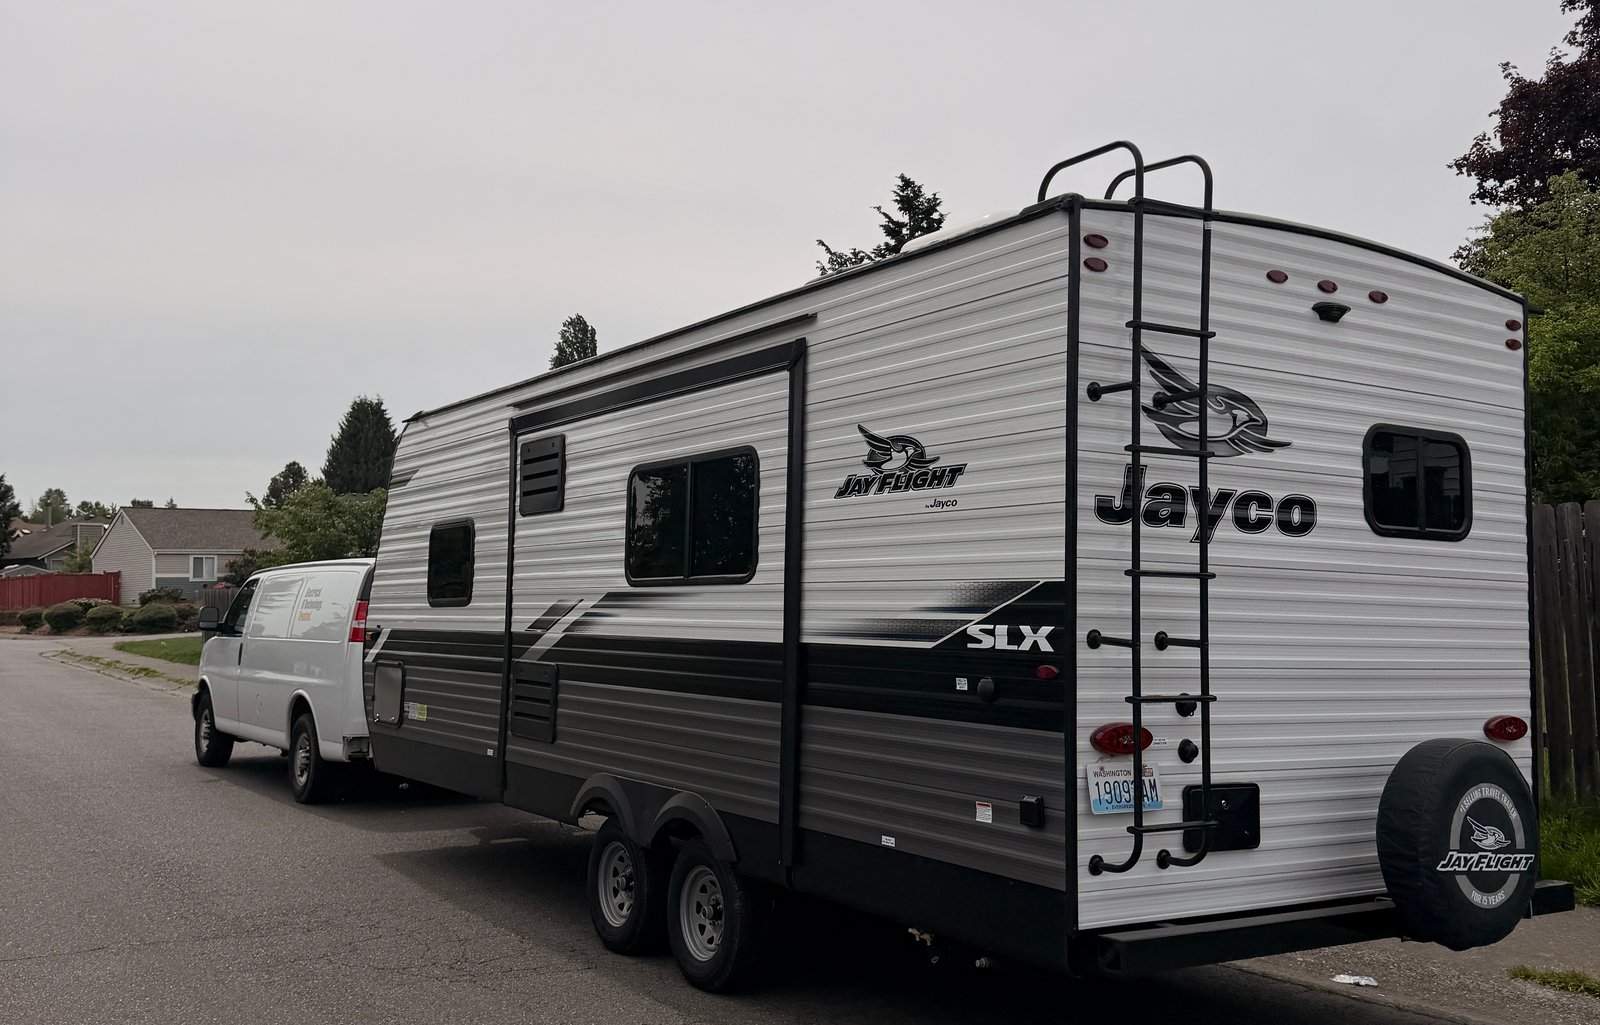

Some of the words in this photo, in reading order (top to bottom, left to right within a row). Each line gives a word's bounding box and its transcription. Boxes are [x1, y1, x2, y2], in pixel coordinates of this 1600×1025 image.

[930, 498, 958, 510] Jayco
[1094, 463, 1318, 544] Jayco
[966, 624, 1055, 652] SLX
[1092, 769, 1132, 778] WASHINGTON
[1095, 779, 1159, 805] 1909AM
[1463, 789, 1482, 808] SELLING
[1481, 787, 1501, 799] TRAVEL
[1500, 793, 1517, 819] TRAILER
[1471, 890, 1482, 903] FOR
[1482, 895, 1488, 905] 15
[1488, 890, 1505, 905] YEARS
